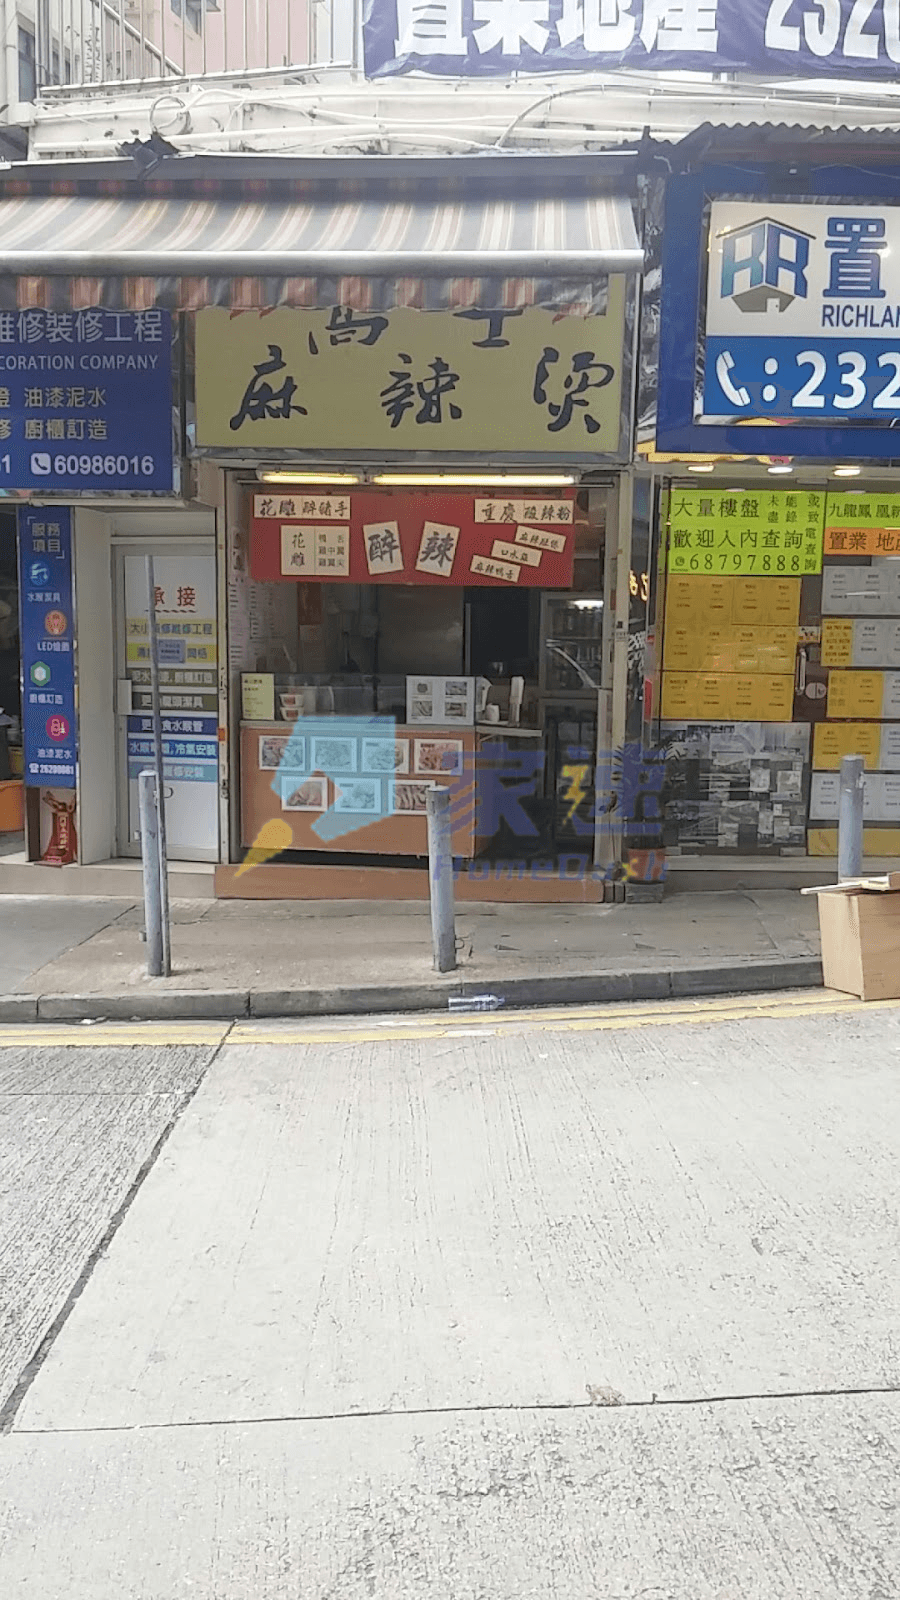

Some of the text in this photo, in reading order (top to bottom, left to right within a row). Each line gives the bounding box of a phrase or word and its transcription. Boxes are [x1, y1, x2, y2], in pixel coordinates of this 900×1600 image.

[823, 217, 887, 298] 置
[80, 355, 158, 370] COMPANY
[24, 387, 106, 408] 油漆泥水
[54, 455, 154, 475] 60986016
[674, 498, 759, 517] 大量樓盤
[689, 554, 800, 572] 68797888
